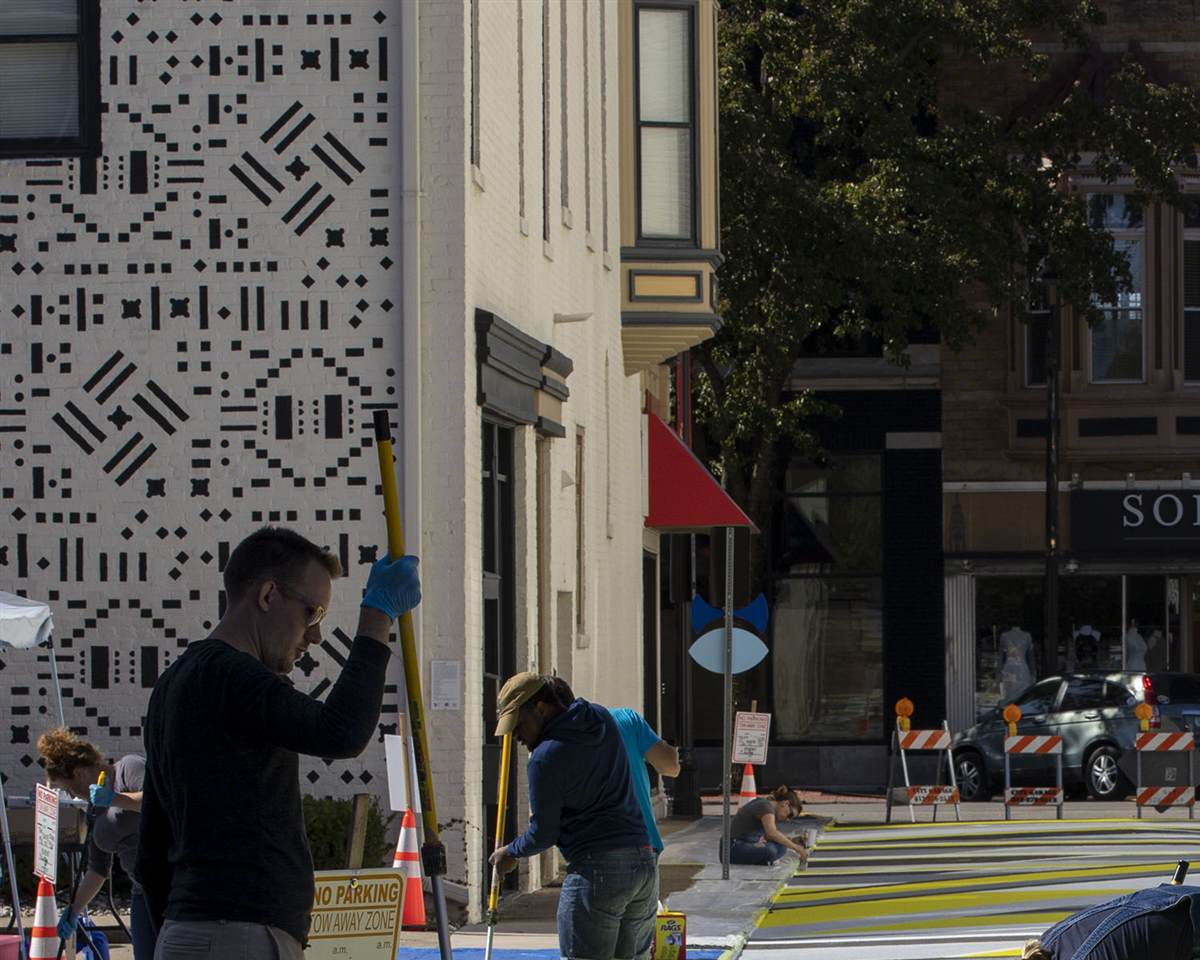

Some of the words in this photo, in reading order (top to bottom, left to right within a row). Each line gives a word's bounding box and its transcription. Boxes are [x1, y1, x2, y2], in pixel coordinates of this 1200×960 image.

[336, 883, 399, 905] PARKING
[333, 911, 364, 930] AWAY
[364, 910, 396, 930] ZONE
